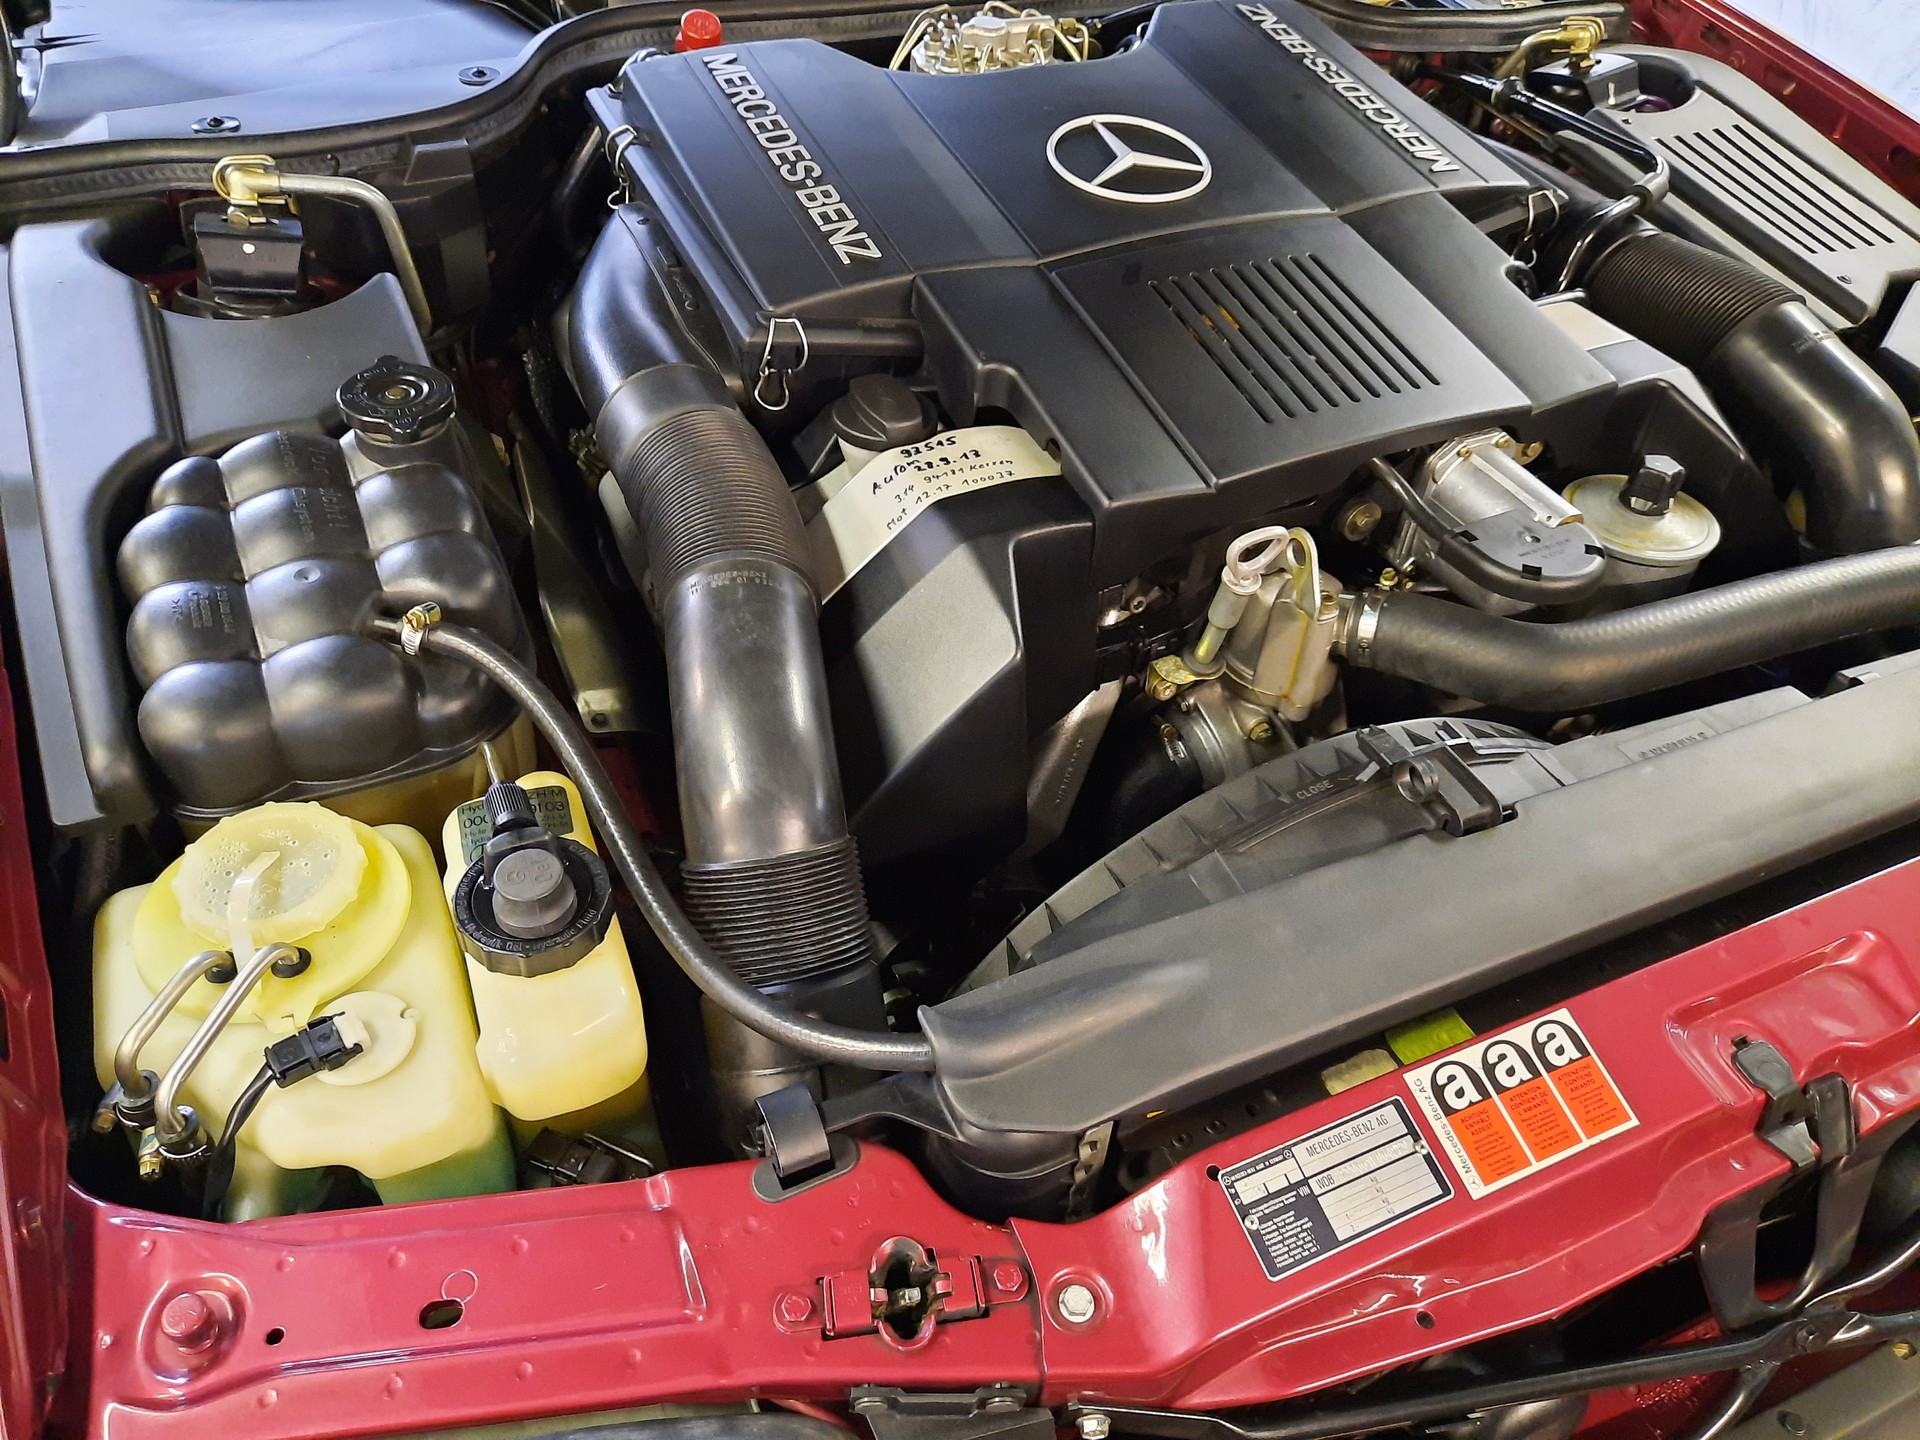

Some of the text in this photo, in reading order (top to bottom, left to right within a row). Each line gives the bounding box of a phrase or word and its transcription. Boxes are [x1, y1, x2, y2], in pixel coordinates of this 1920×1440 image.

[1236, 3, 1461, 173] MERCEDES-BENZ
[702, 52, 883, 265] MERCEDES-BENZ
[1295, 779, 1334, 800] CLOSE
[576, 908, 598, 929] Fluid
[1435, 1022, 1582, 1111] a a a
[1305, 1119, 1375, 1158] MERCEDES-BENZ
[1376, 1113, 1389, 1127] AG
[1413, 1078, 1473, 1174] Mercedes-Benz AG
[1297, 1173, 1336, 1198] VIN WDB
[1370, 1175, 1379, 1184] kg
[1375, 1185, 1385, 1195] kg
[1381, 1196, 1390, 1206] kg
[1387, 1206, 1396, 1216] kg
